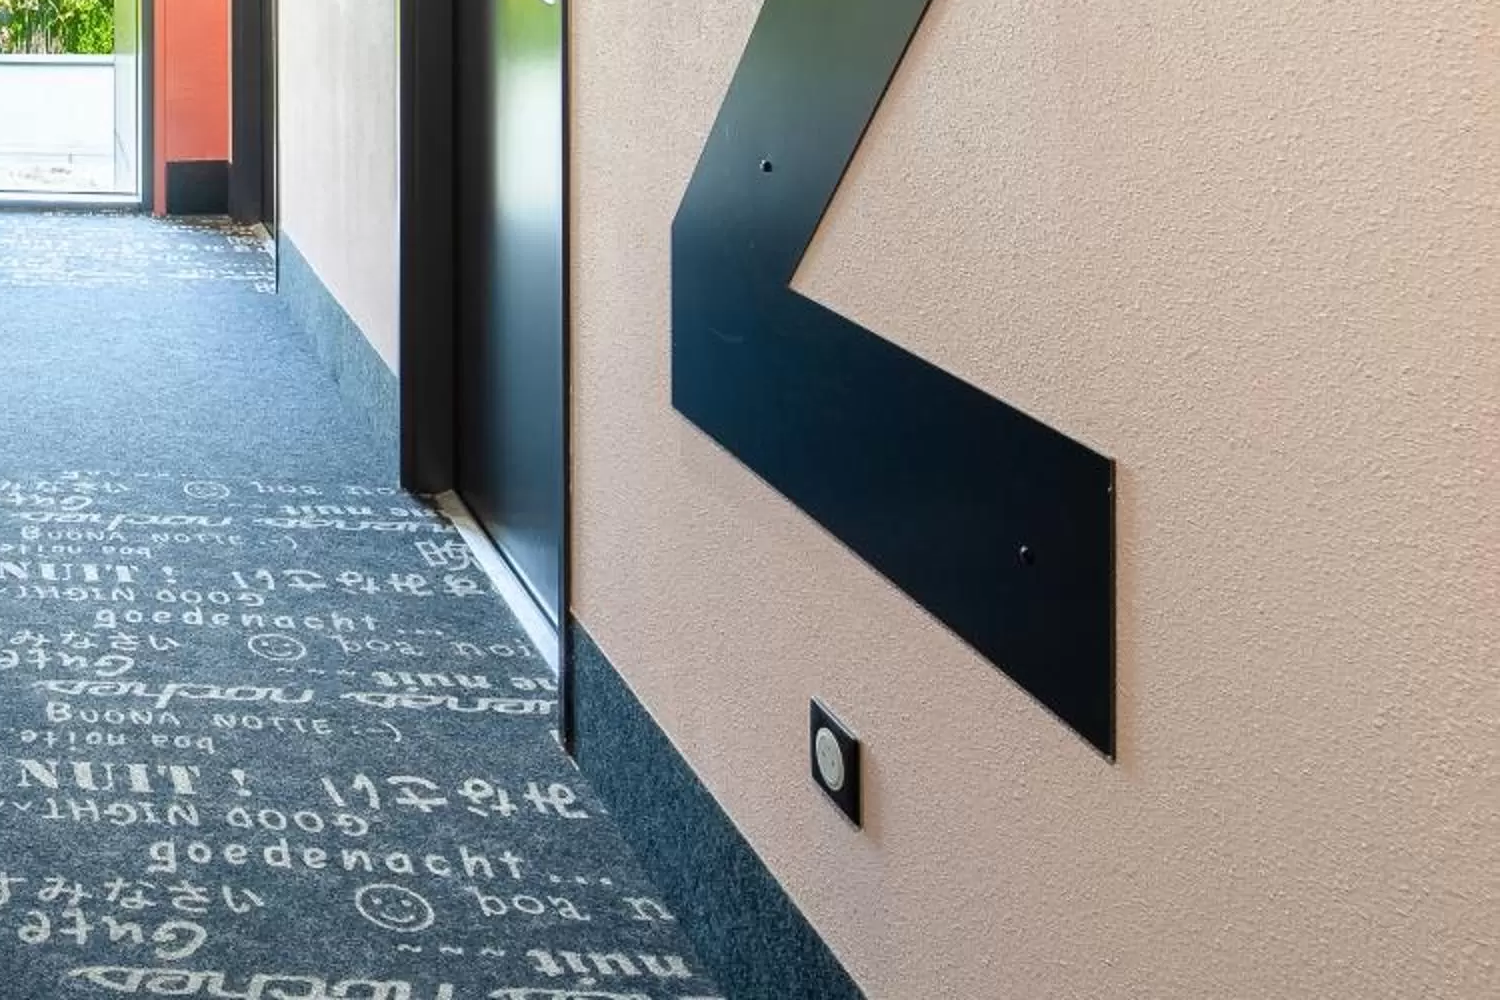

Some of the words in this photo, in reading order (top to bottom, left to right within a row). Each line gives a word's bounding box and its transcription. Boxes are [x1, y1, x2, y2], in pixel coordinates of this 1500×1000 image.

[16, 757, 203, 796] NUIT
[226, 806, 369, 837] GOOD
[16, 906, 208, 961] Gute
[526, 949, 693, 987] nuit
